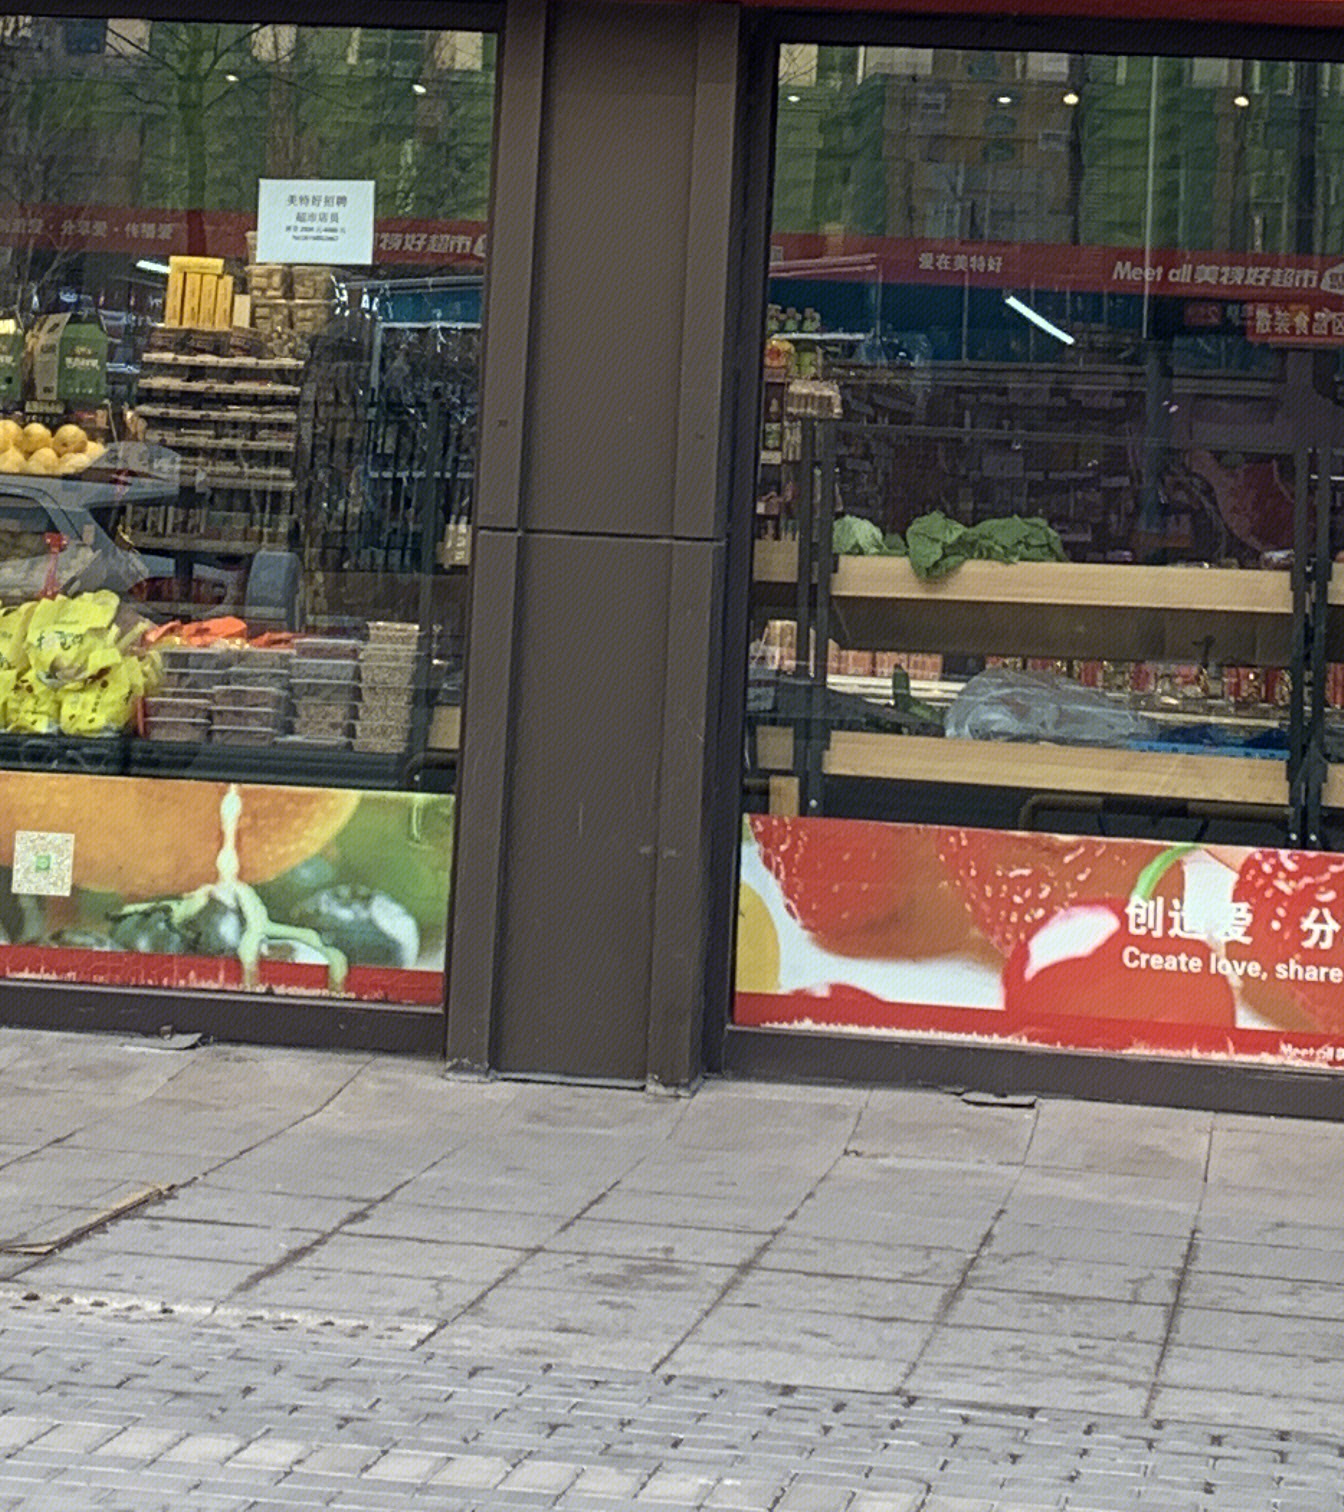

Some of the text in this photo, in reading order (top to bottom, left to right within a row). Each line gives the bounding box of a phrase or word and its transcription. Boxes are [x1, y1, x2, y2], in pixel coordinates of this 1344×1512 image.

[287, 194, 348, 208] 美特好招聘
[375, 231, 473, 256] 特好超市
[1112, 260, 1164, 283] Meet
[1167, 263, 1193, 284] all
[1193, 265, 1320, 289] 美特好超市
[1122, 945, 1203, 972] Create
[1209, 952, 1268, 979] love,
[1274, 961, 1344, 985] share
